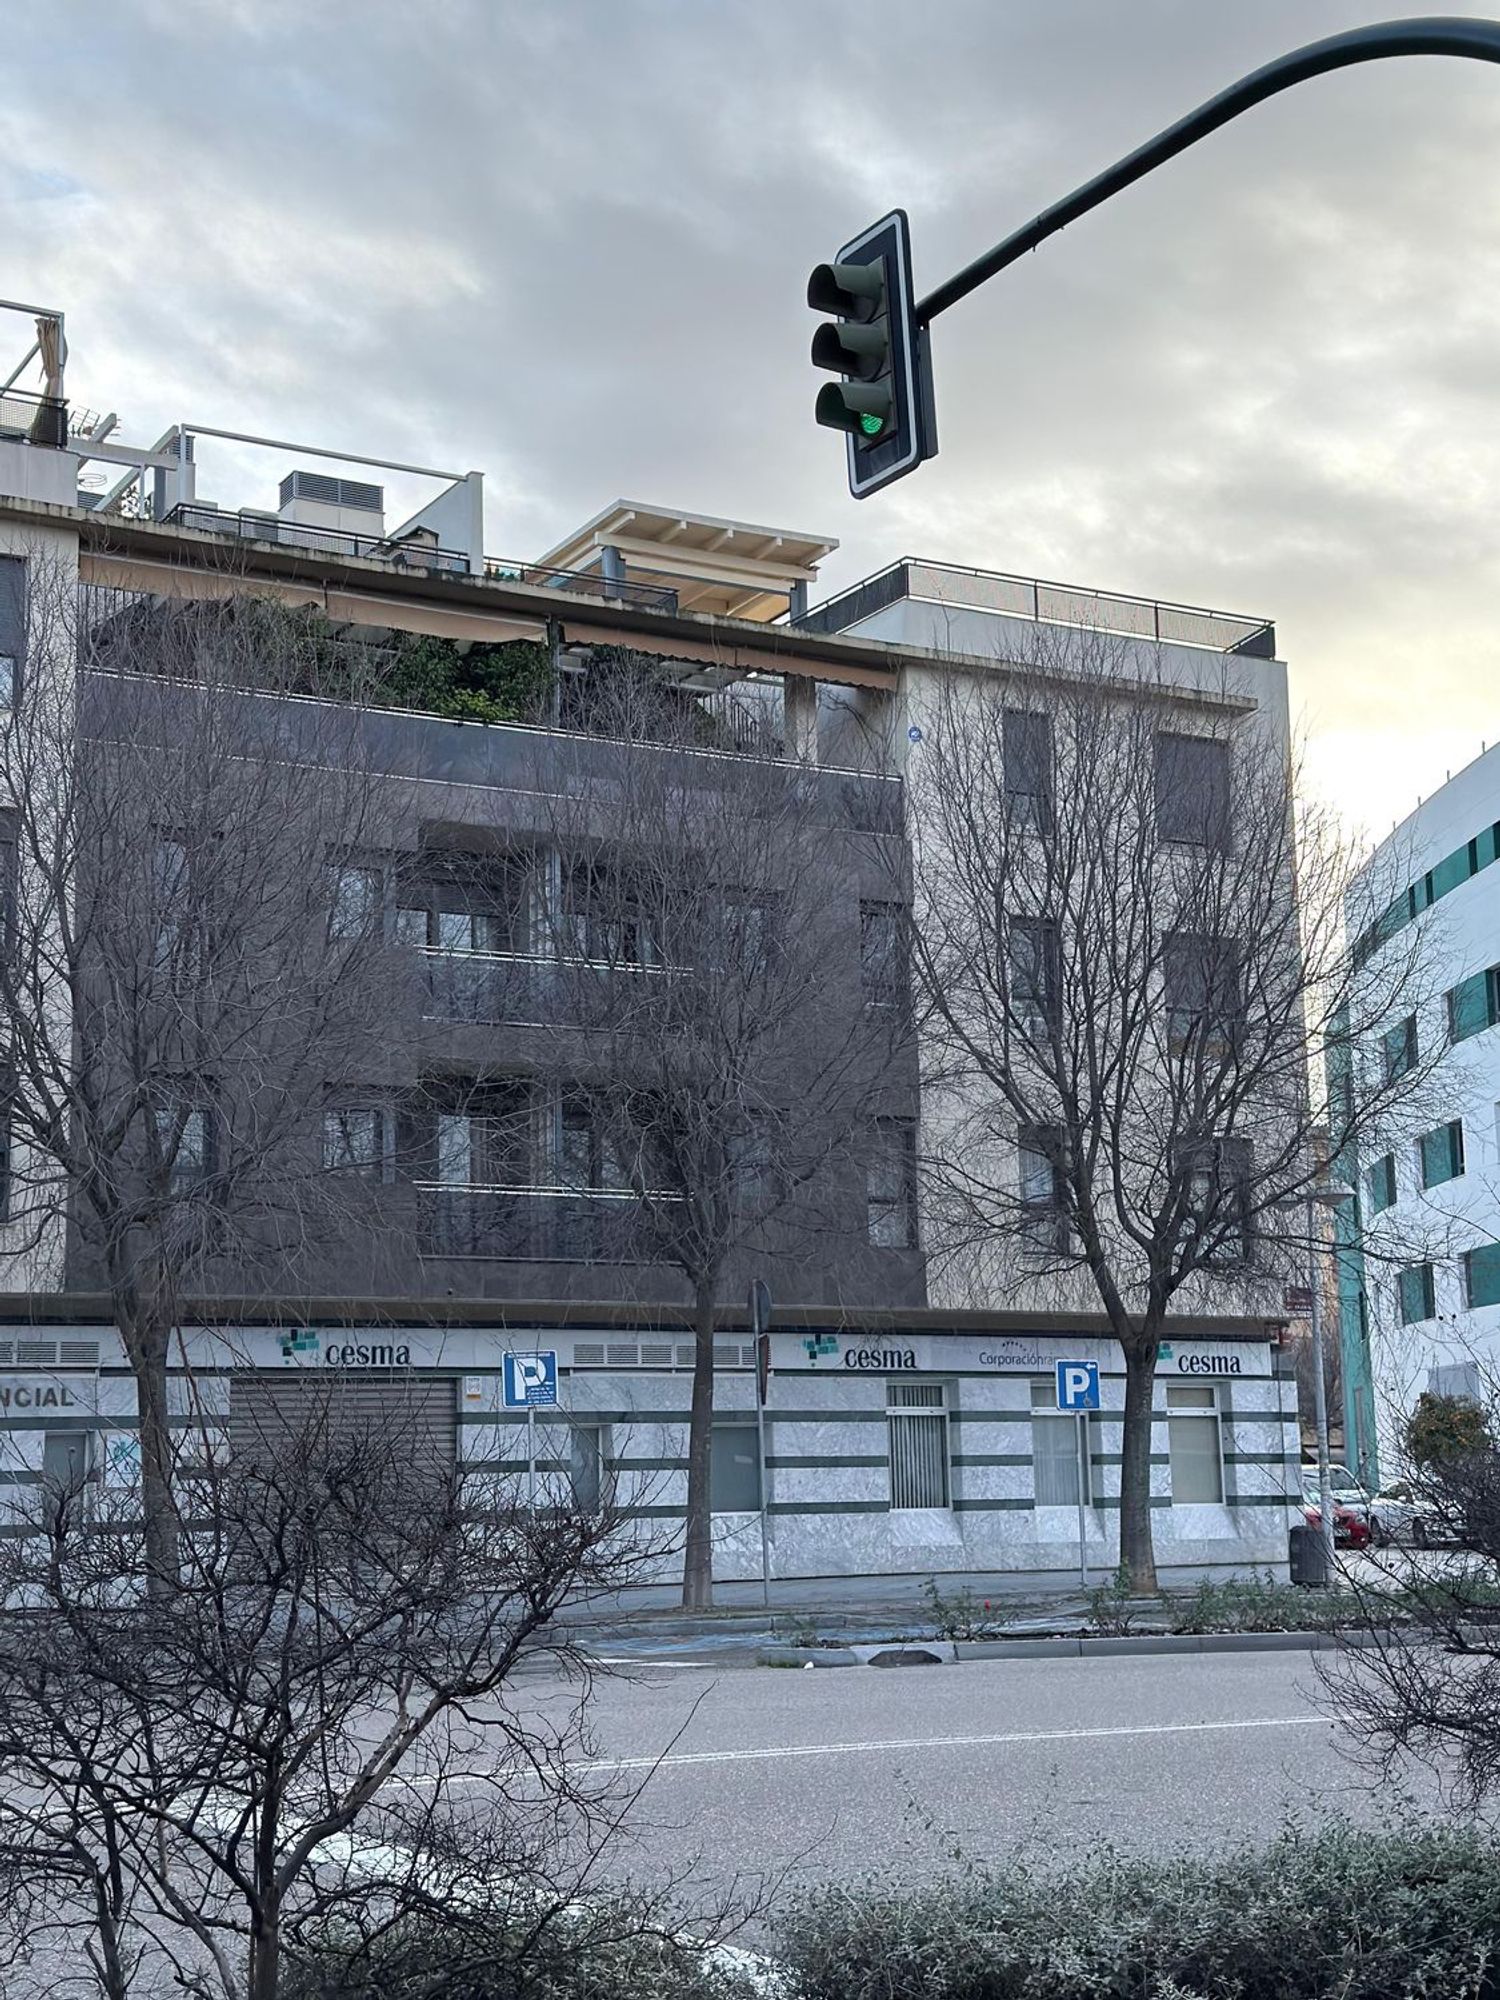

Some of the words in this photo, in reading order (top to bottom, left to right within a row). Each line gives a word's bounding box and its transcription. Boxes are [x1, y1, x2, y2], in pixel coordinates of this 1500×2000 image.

[326, 1344, 412, 1366] cesma
[844, 1349, 917, 1369] cesma
[1178, 1354, 1242, 1373] cesma
[513, 1358, 547, 1400] P
[1065, 1367, 1090, 1405] P
